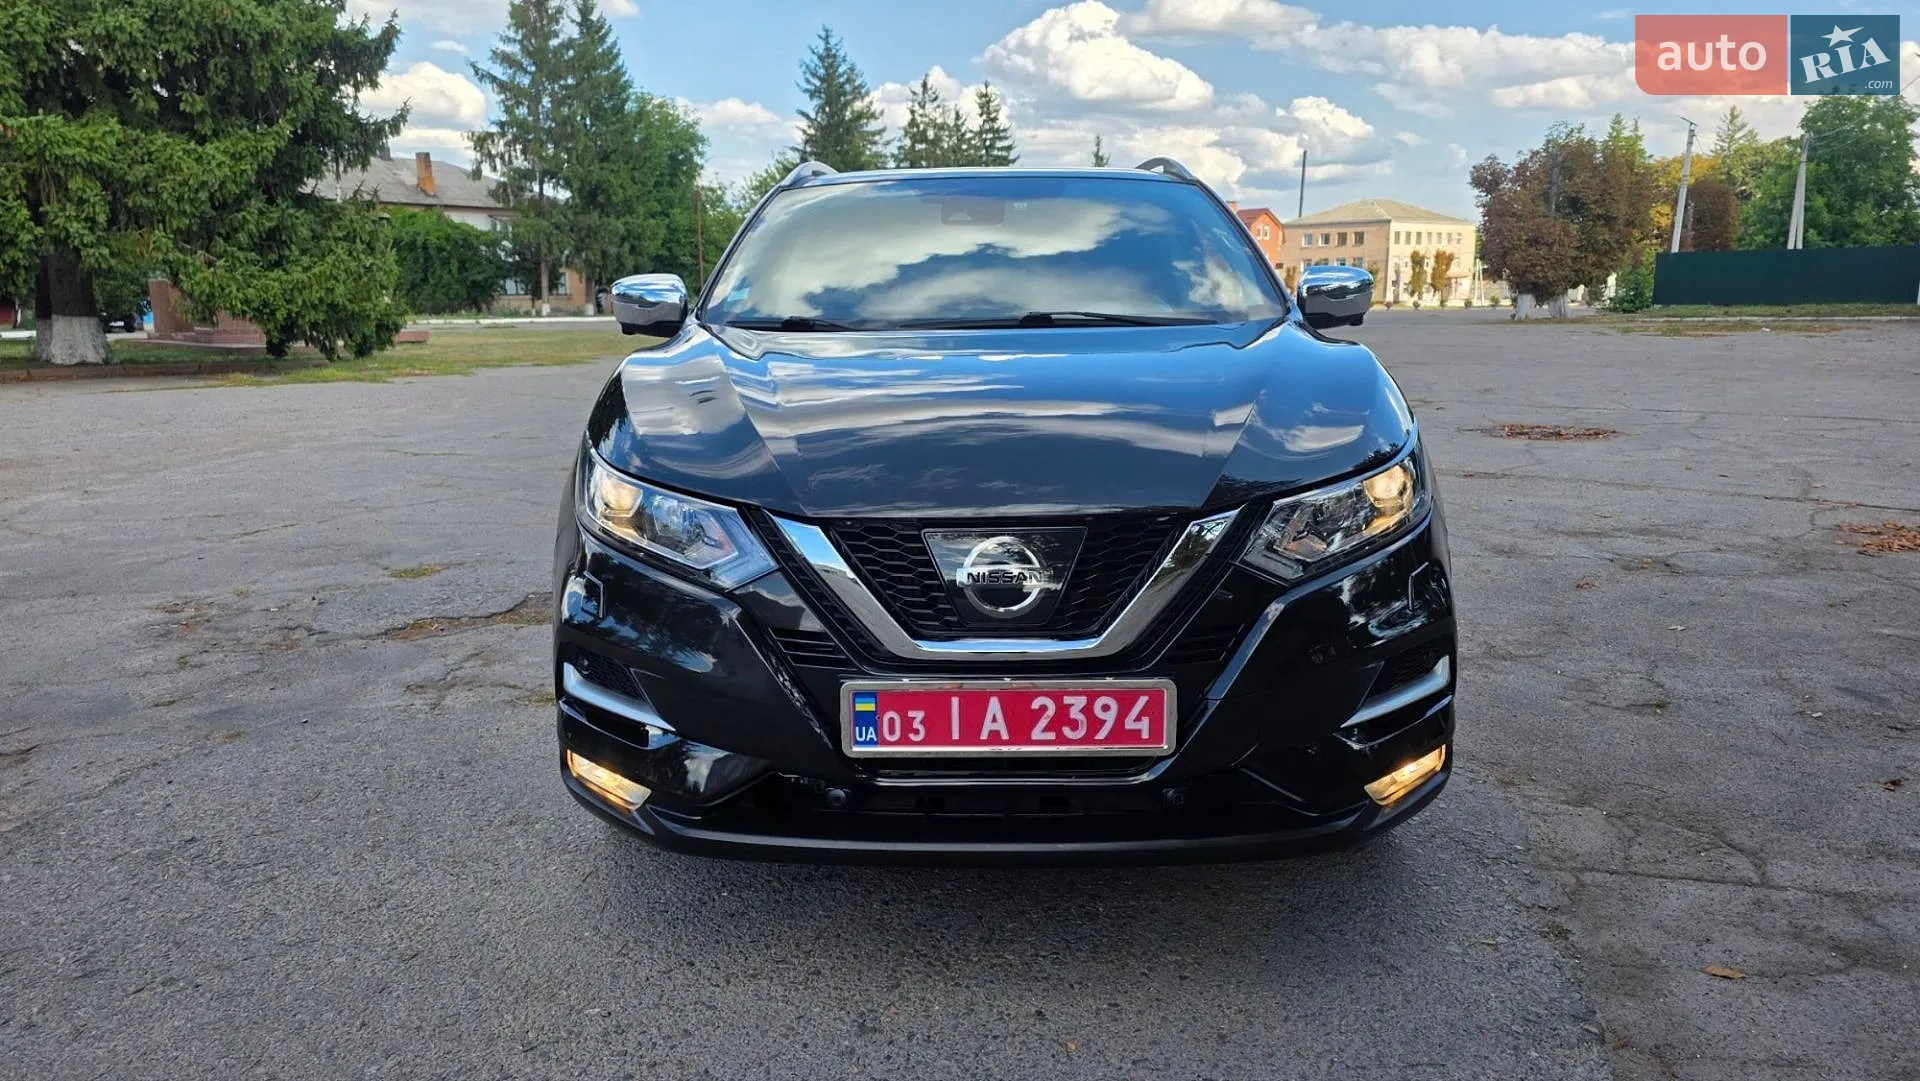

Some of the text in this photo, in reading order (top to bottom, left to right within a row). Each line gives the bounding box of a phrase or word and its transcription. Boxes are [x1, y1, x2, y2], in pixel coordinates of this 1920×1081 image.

[966, 571, 1041, 585] NISSAN
[882, 695, 1150, 742] 03 IA 2394
[855, 726, 877, 742] UA
